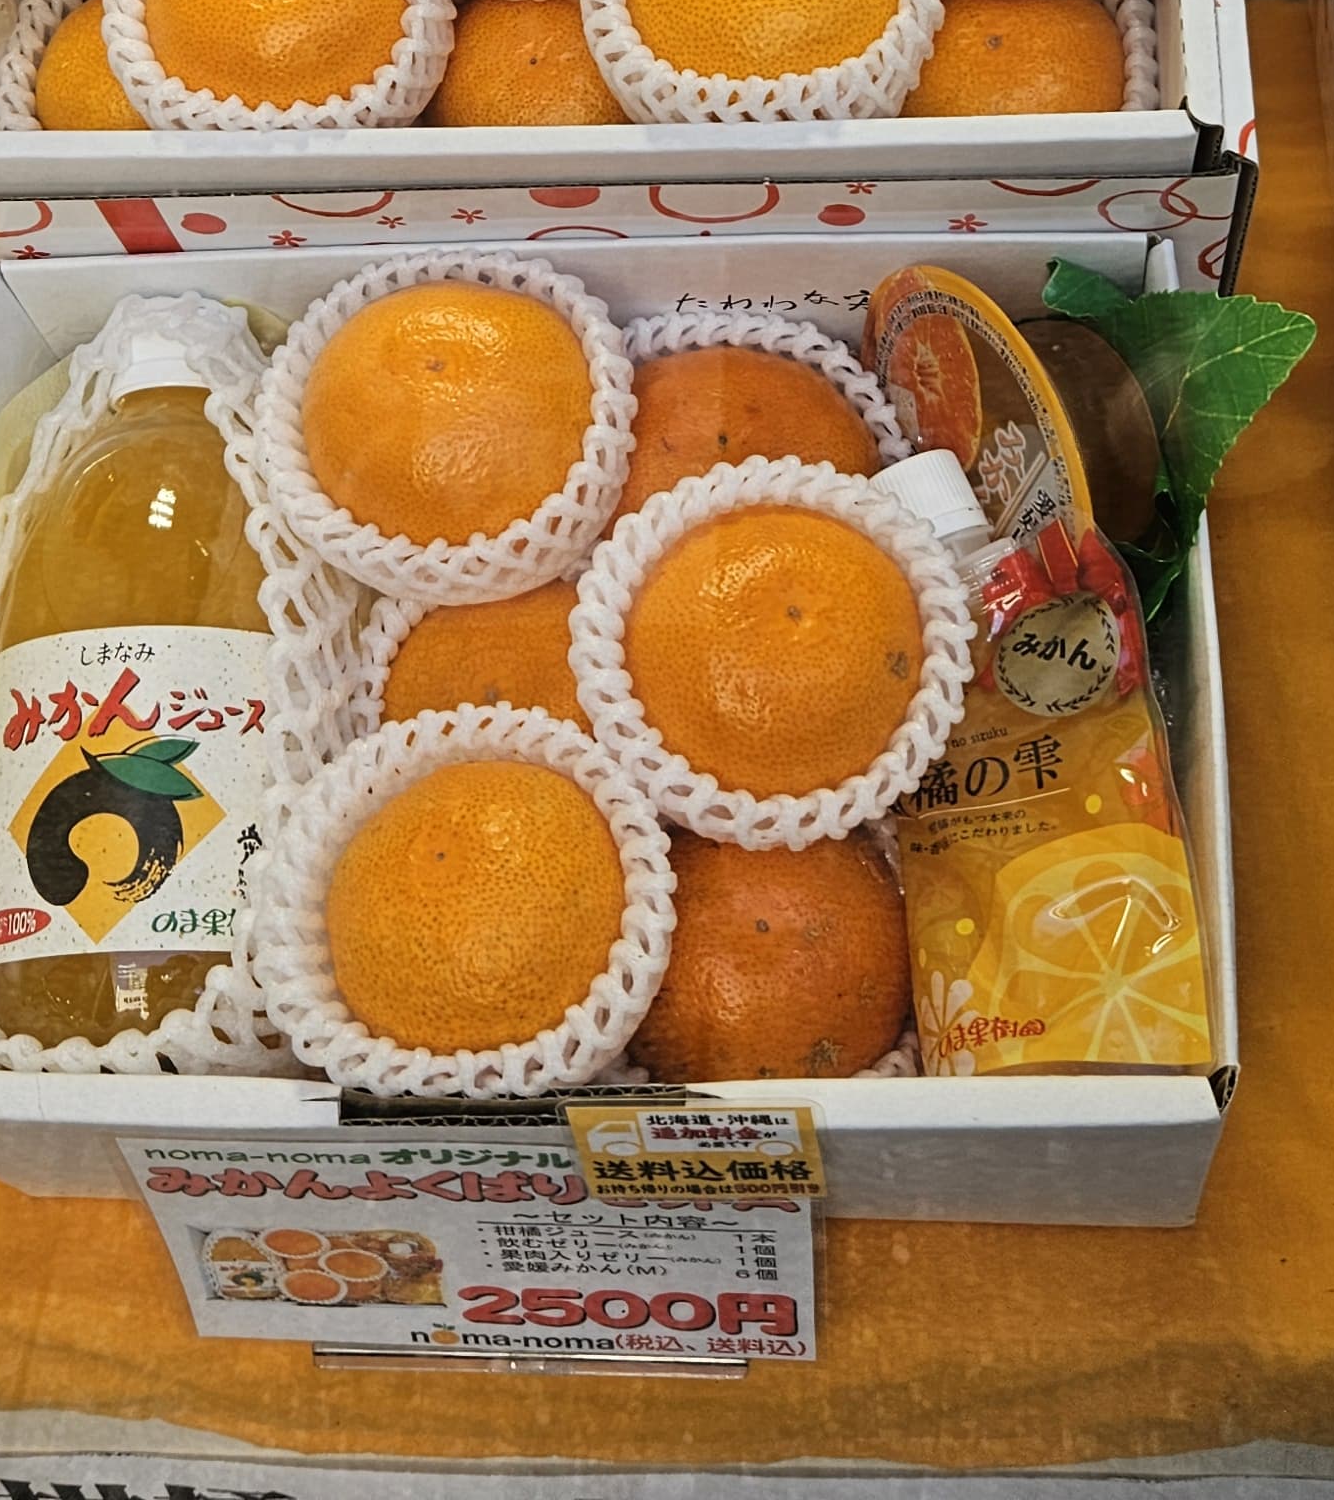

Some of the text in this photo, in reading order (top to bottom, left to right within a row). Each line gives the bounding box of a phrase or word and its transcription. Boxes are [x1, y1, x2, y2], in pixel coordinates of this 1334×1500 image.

[79, 642, 156, 666] しまなみ
[1011, 632, 1097, 672] みかん
[3, 667, 267, 752] みかんジュース
[891, 734, 1065, 815] 橘の雫
[7, 911, 37, 935] 100%
[646, 1114, 790, 1127] 北海道・沖縄は
[651, 1126, 777, 1140] 追加料金が
[143, 1146, 575, 1170] noma-noma オリジナル
[592, 1159, 814, 1182] 送料込価格
[146, 1165, 591, 1206] みかんよくばり
[458, 1285, 799, 1337] 2500円
[615, 1335, 807, 1358] (税込、送料込)
